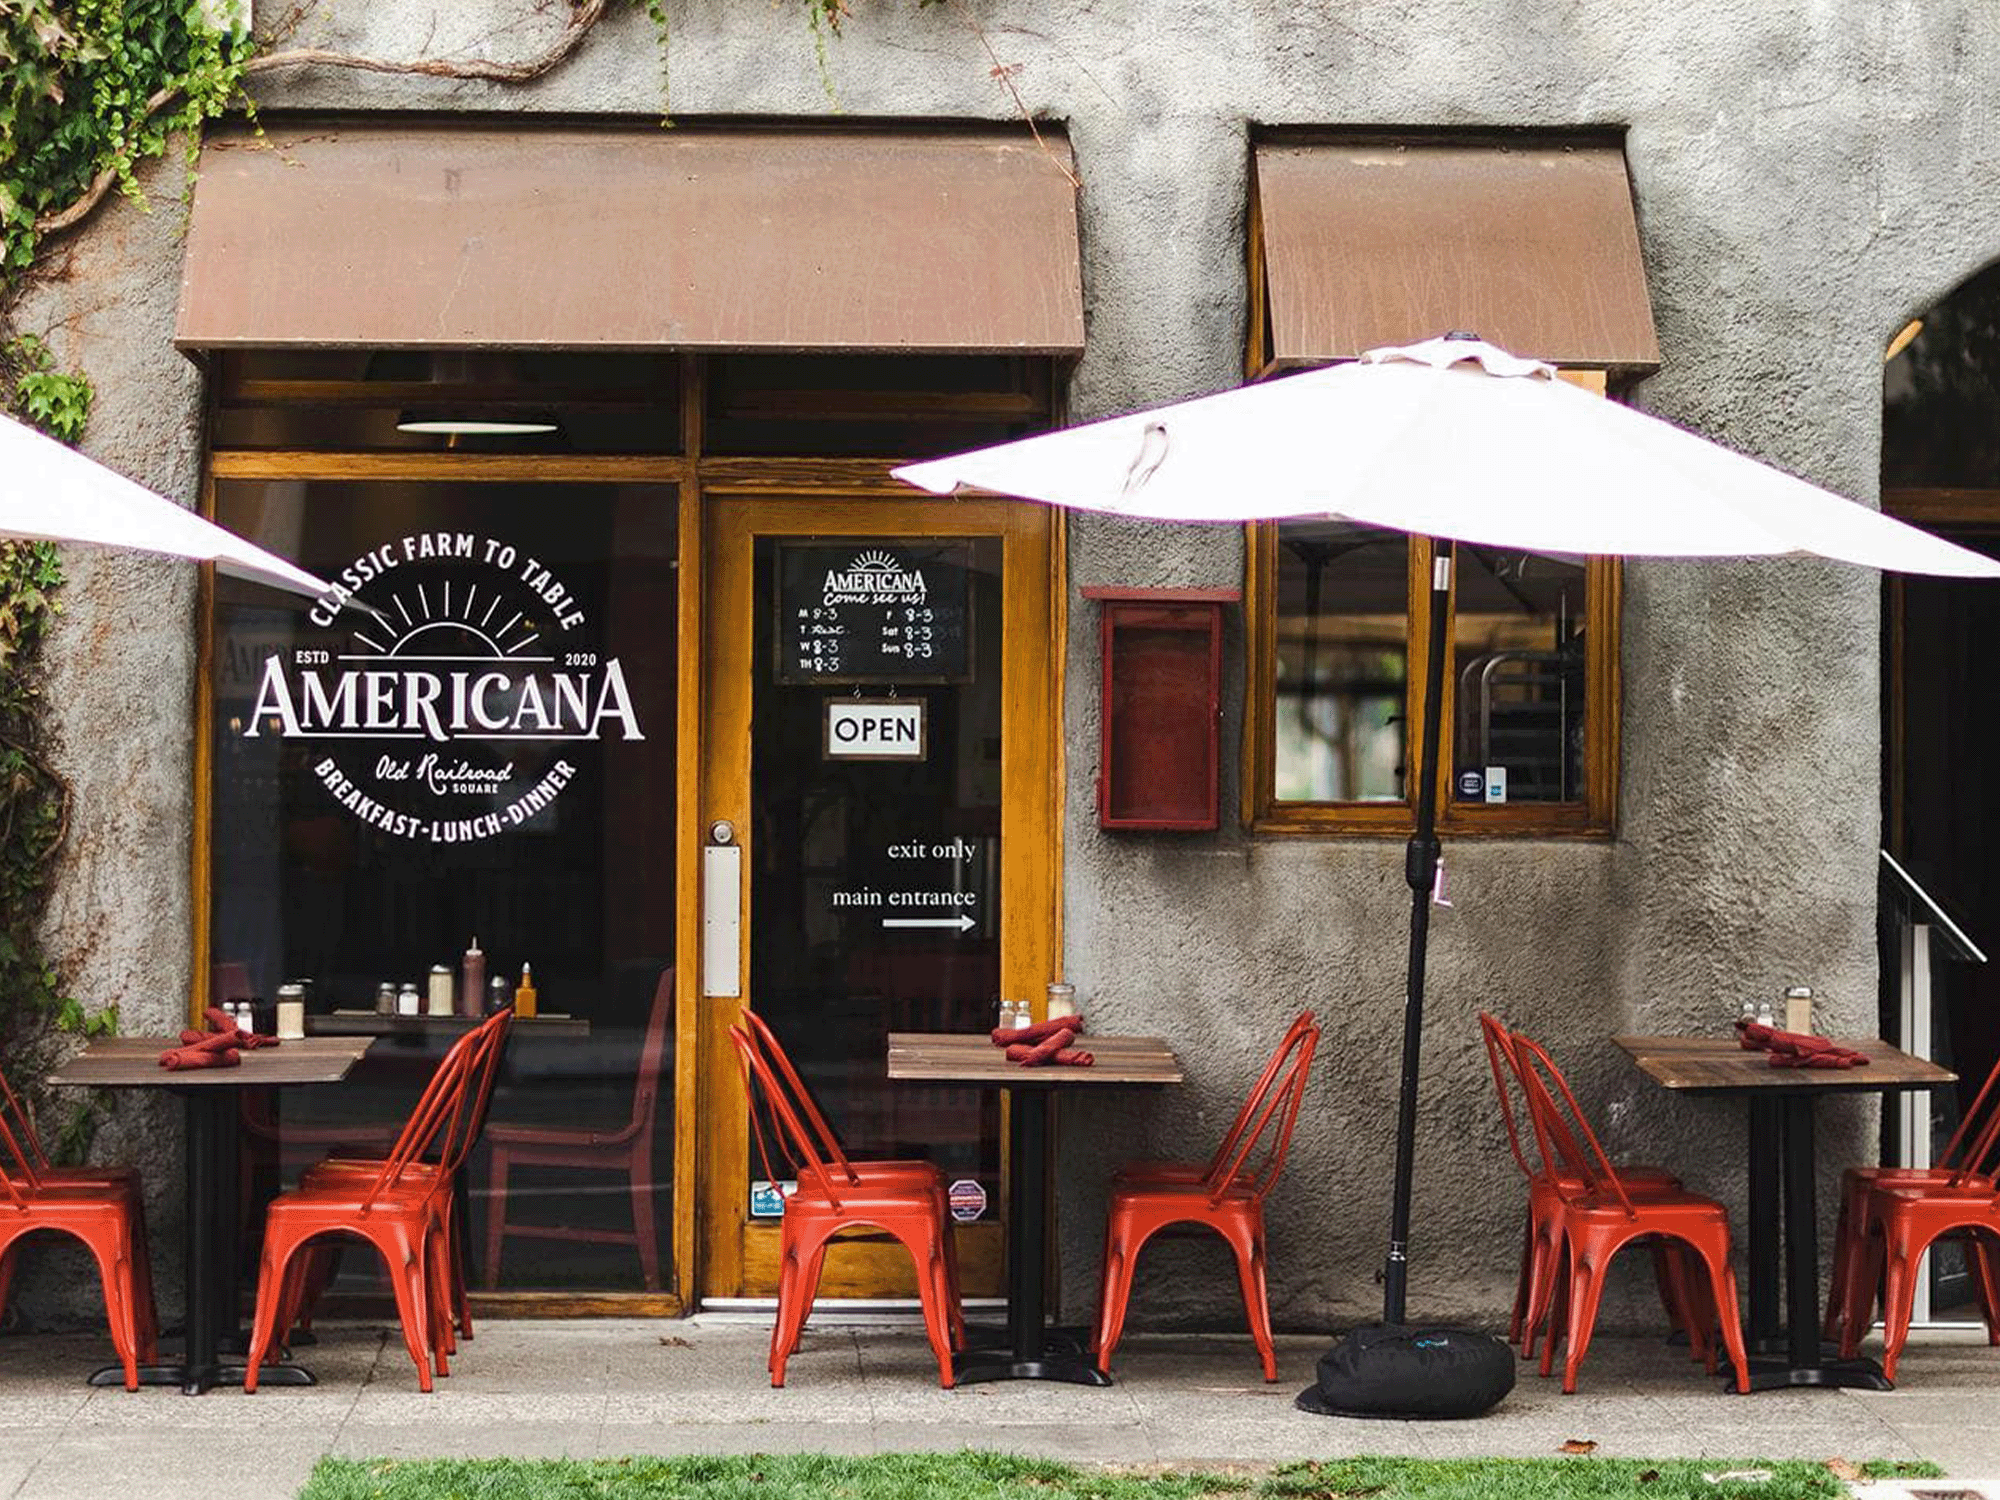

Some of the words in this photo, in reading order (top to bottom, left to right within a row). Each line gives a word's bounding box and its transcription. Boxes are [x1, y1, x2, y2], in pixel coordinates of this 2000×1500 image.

[310, 545, 397, 627] CLASSIC
[402, 532, 475, 562] FARM
[484, 537, 518, 570] TO
[520, 559, 584, 631] TABLE
[823, 570, 927, 592] AMERICANA
[823, 592, 870, 607] Come
[871, 593, 898, 605] see
[901, 592, 927, 606] us!
[905, 607, 934, 623] 8-3
[904, 626, 933, 641] 8-3
[295, 650, 329, 665] ESTD
[564, 652, 597, 667] 2020
[903, 643, 933, 659] 8-3
[243, 654, 645, 742] AMERICANA
[835, 717, 916, 742] OPEN
[375, 753, 411, 782] Old
[415, 753, 513, 795] Railroad
[452, 783, 499, 795] SQUARE
[887, 839, 926, 859] exit
[931, 840, 977, 863] only
[832, 887, 882, 906] main
[888, 890, 976, 906] entrance
